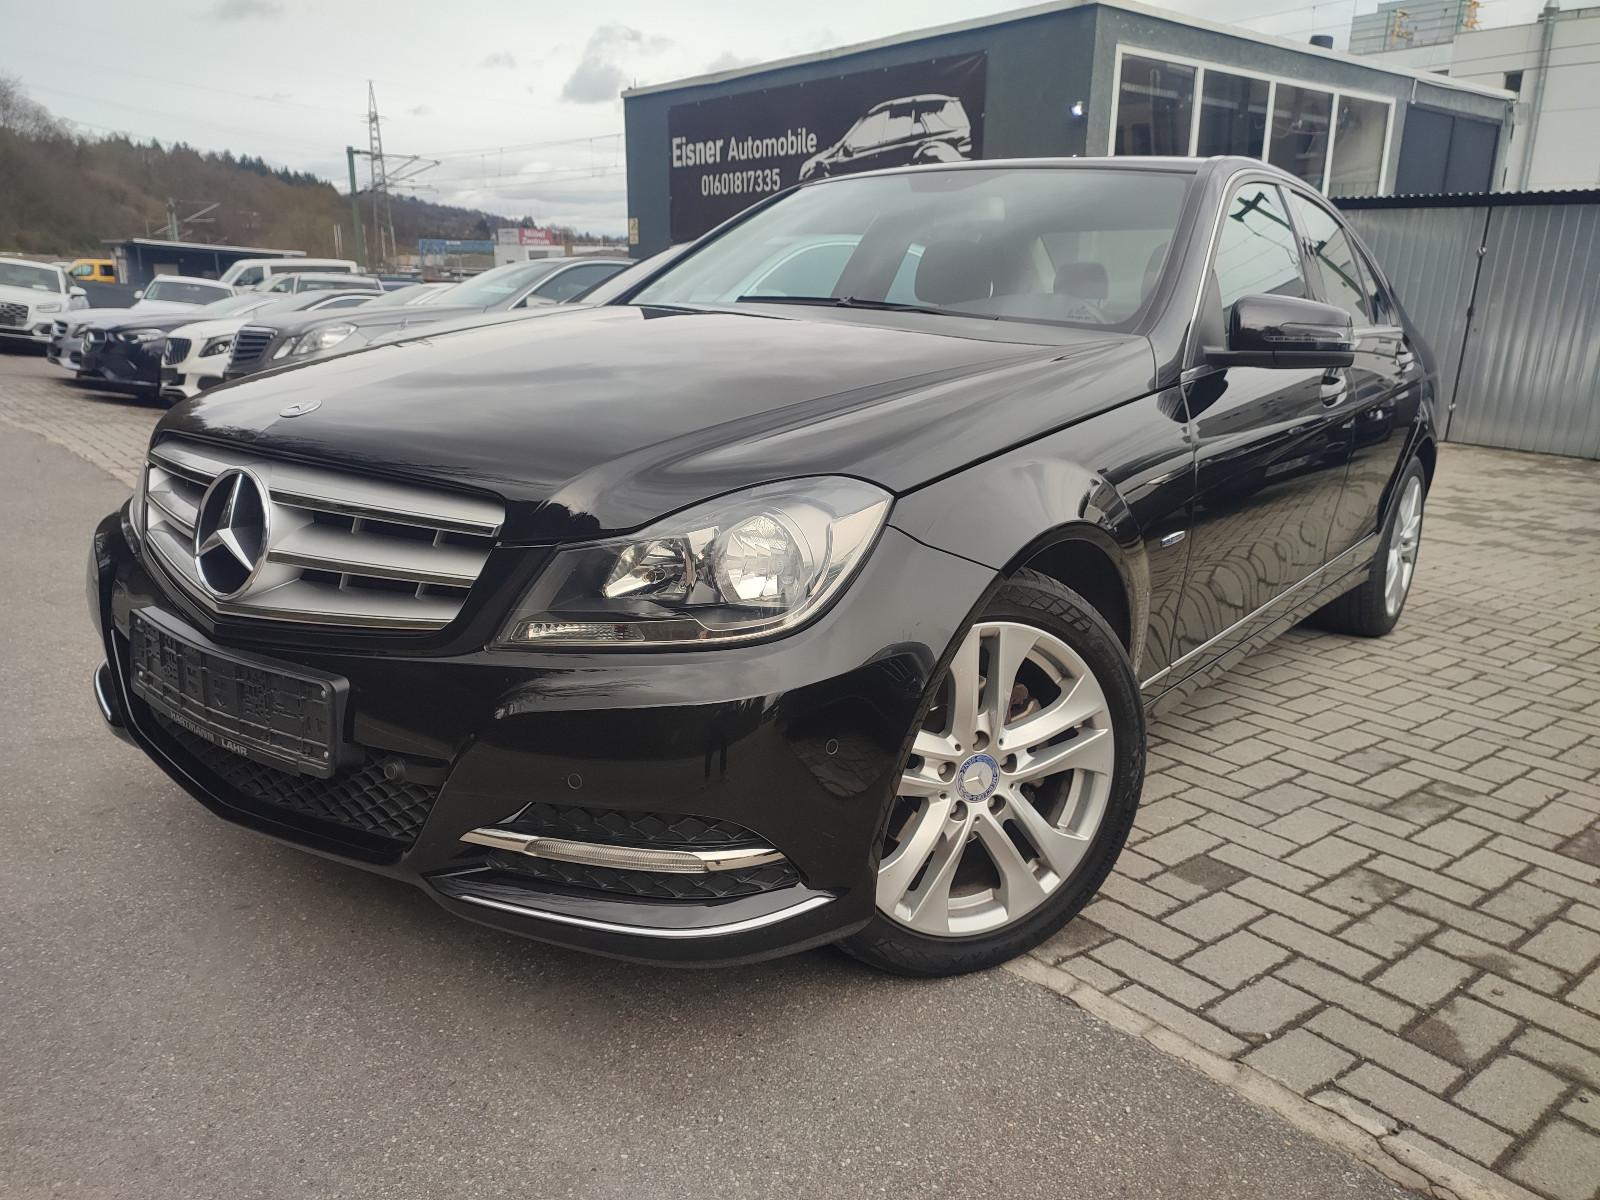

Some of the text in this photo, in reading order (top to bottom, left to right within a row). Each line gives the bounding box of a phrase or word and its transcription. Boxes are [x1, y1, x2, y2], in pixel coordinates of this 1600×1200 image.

[672, 127, 817, 167] Eisner Automobile
[701, 168, 780, 196] 01601817335
[221, 738, 248, 757] LAHR
